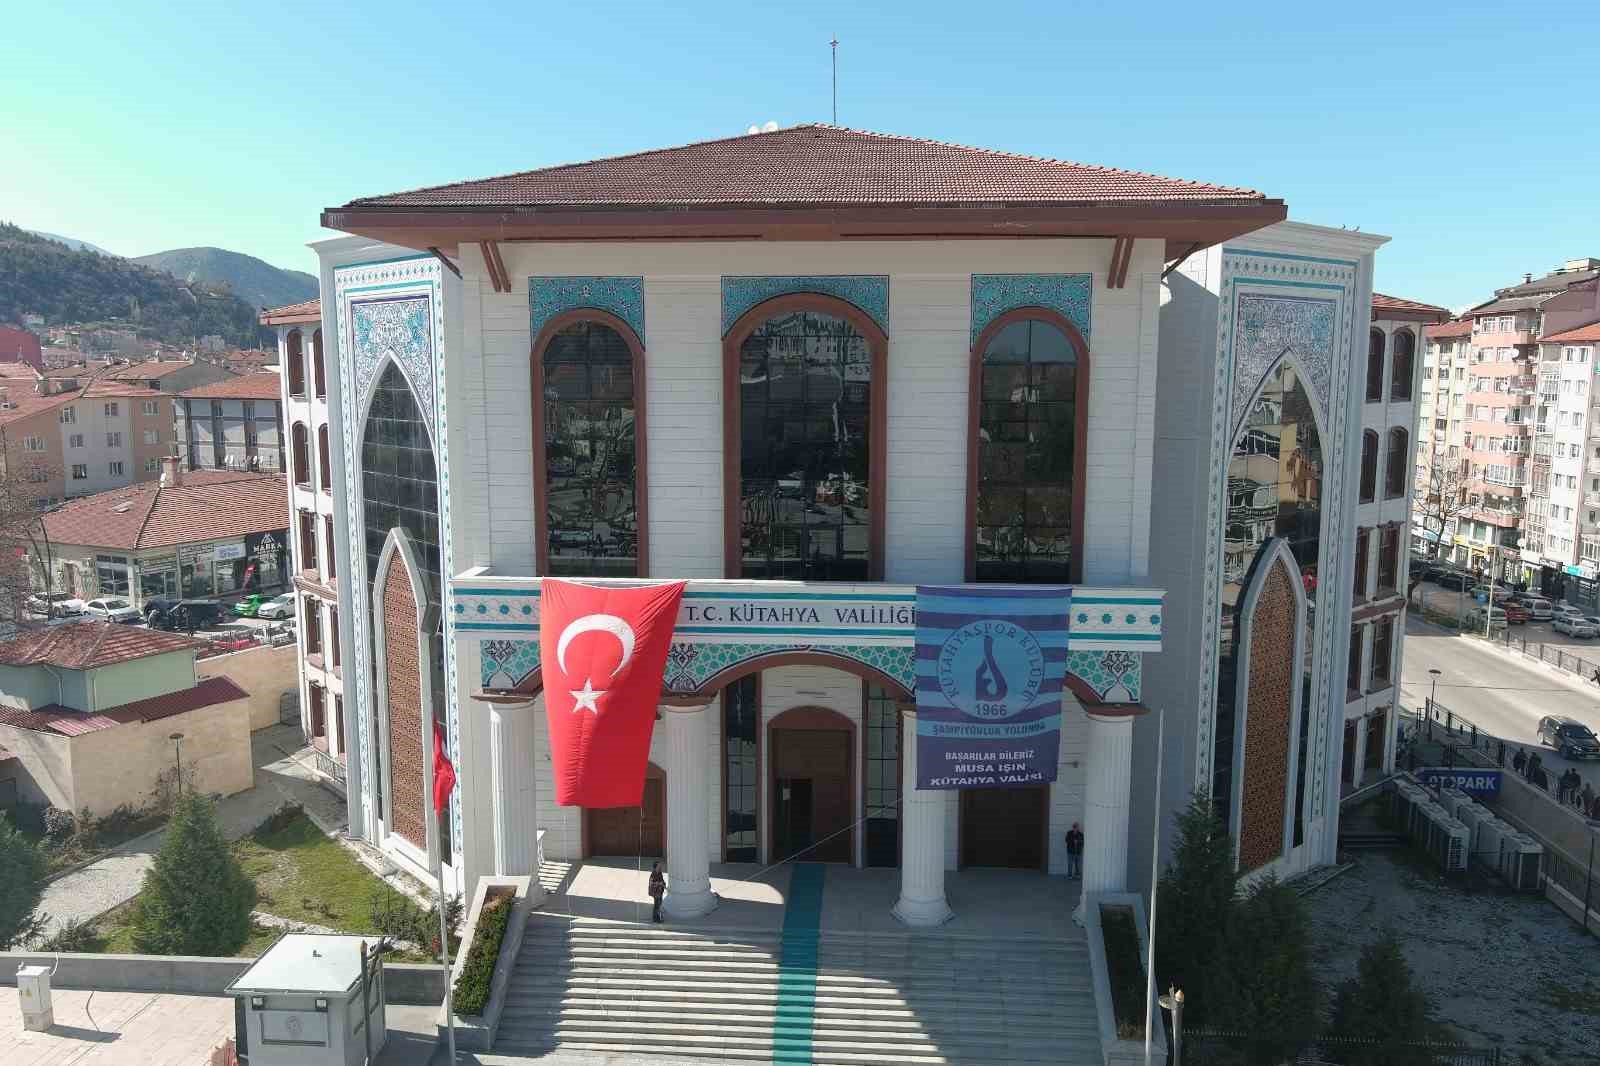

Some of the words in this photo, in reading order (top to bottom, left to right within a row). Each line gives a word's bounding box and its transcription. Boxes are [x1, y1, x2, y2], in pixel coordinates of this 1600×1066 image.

[730, 604, 821, 623] KÜTAHYA
[976, 703, 1008, 716] 1966
[945, 751, 996, 761] BAŞARILAR
[955, 764, 994, 773] MUSA
[930, 776, 995, 786] KÜTAHYA
[1429, 775, 1496, 790] OTOPARK
